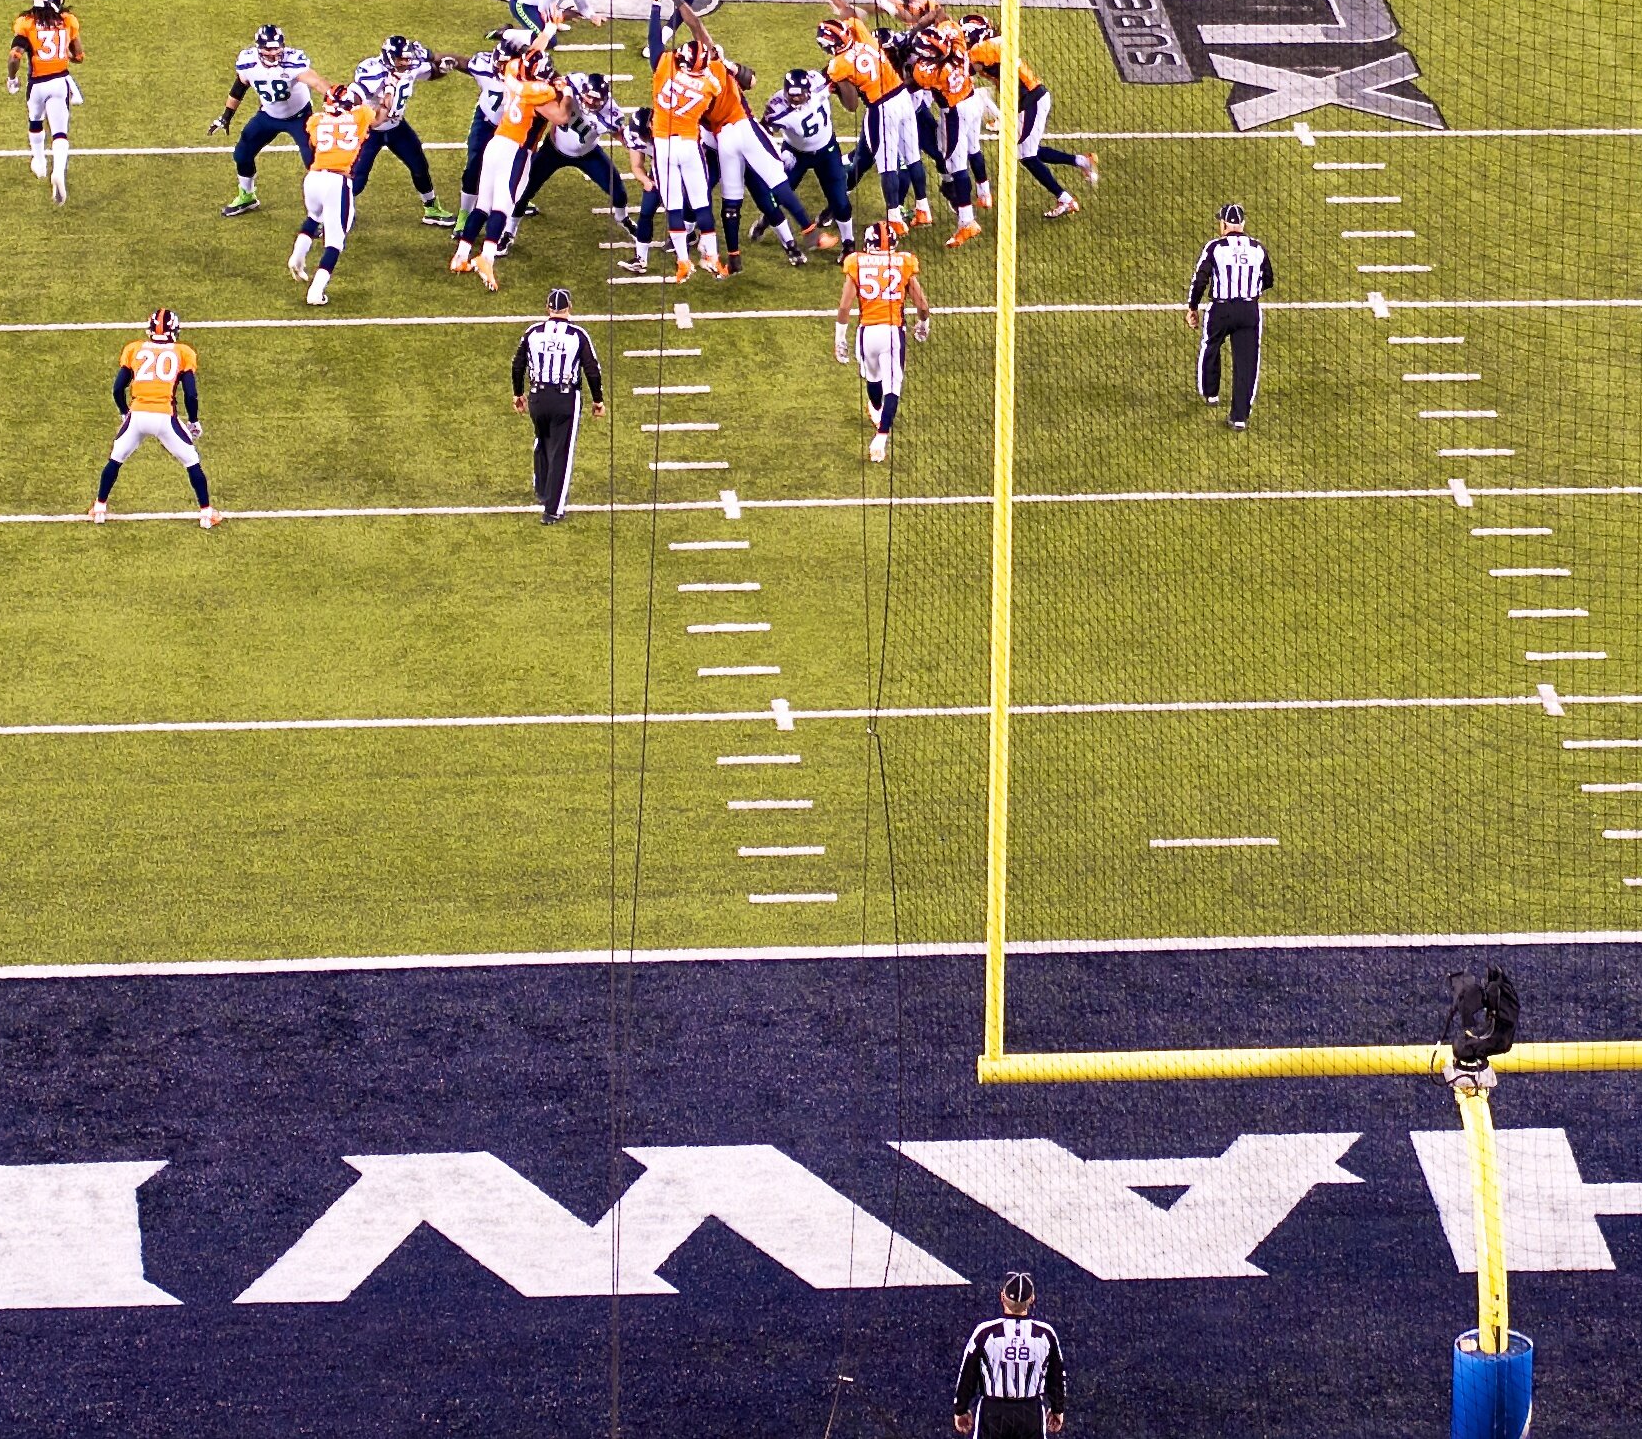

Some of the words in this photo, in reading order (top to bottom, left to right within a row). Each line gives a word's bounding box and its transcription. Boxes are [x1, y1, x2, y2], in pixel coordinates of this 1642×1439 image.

[37, 28, 67, 60] 31
[253, 79, 292, 102] 58
[657, 78, 704, 116] 57
[316, 124, 360, 152] 53
[800, 106, 829, 138] 61
[858, 267, 902, 300] 52
[539, 341, 566, 353] 124
[135, 349, 179, 382] 20
[1003, 1346, 1031, 1361] 88
